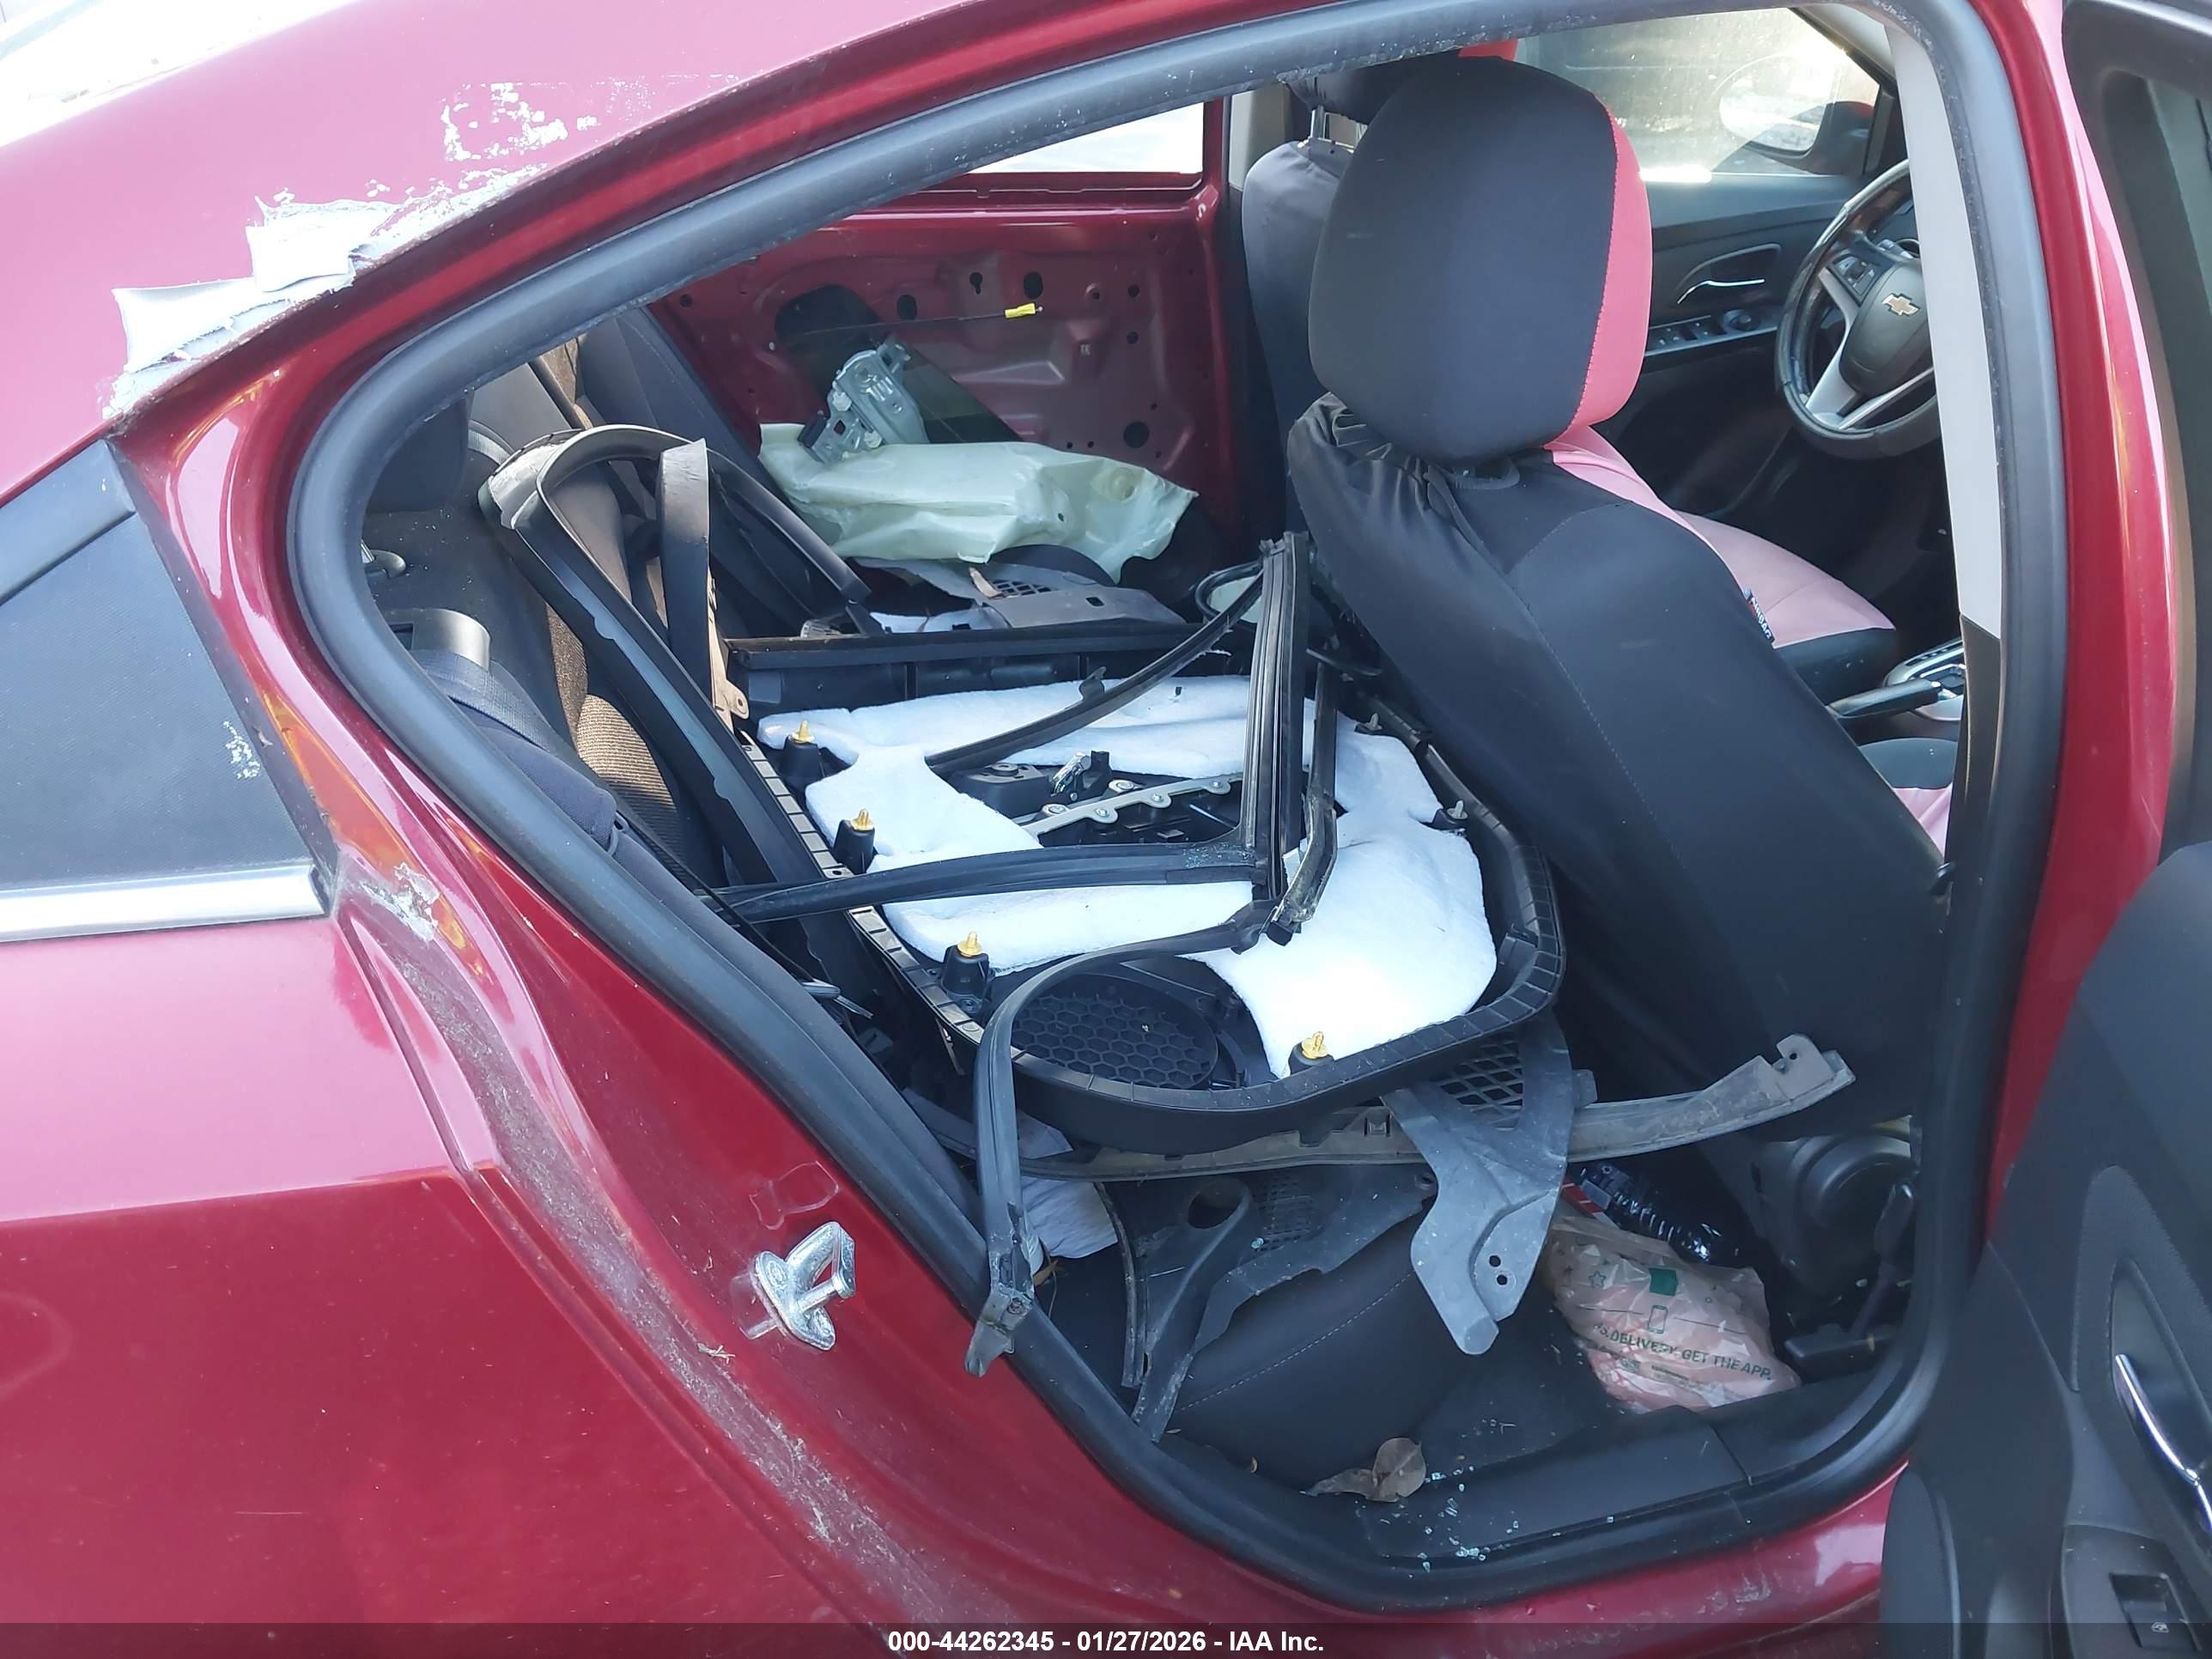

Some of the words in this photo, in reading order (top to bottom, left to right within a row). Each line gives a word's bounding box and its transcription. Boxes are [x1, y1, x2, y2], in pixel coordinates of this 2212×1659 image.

[1681, 1349, 1710, 1364] GET
[1712, 1354, 1741, 1370] THE
[1741, 1362, 1771, 1381] APP.
